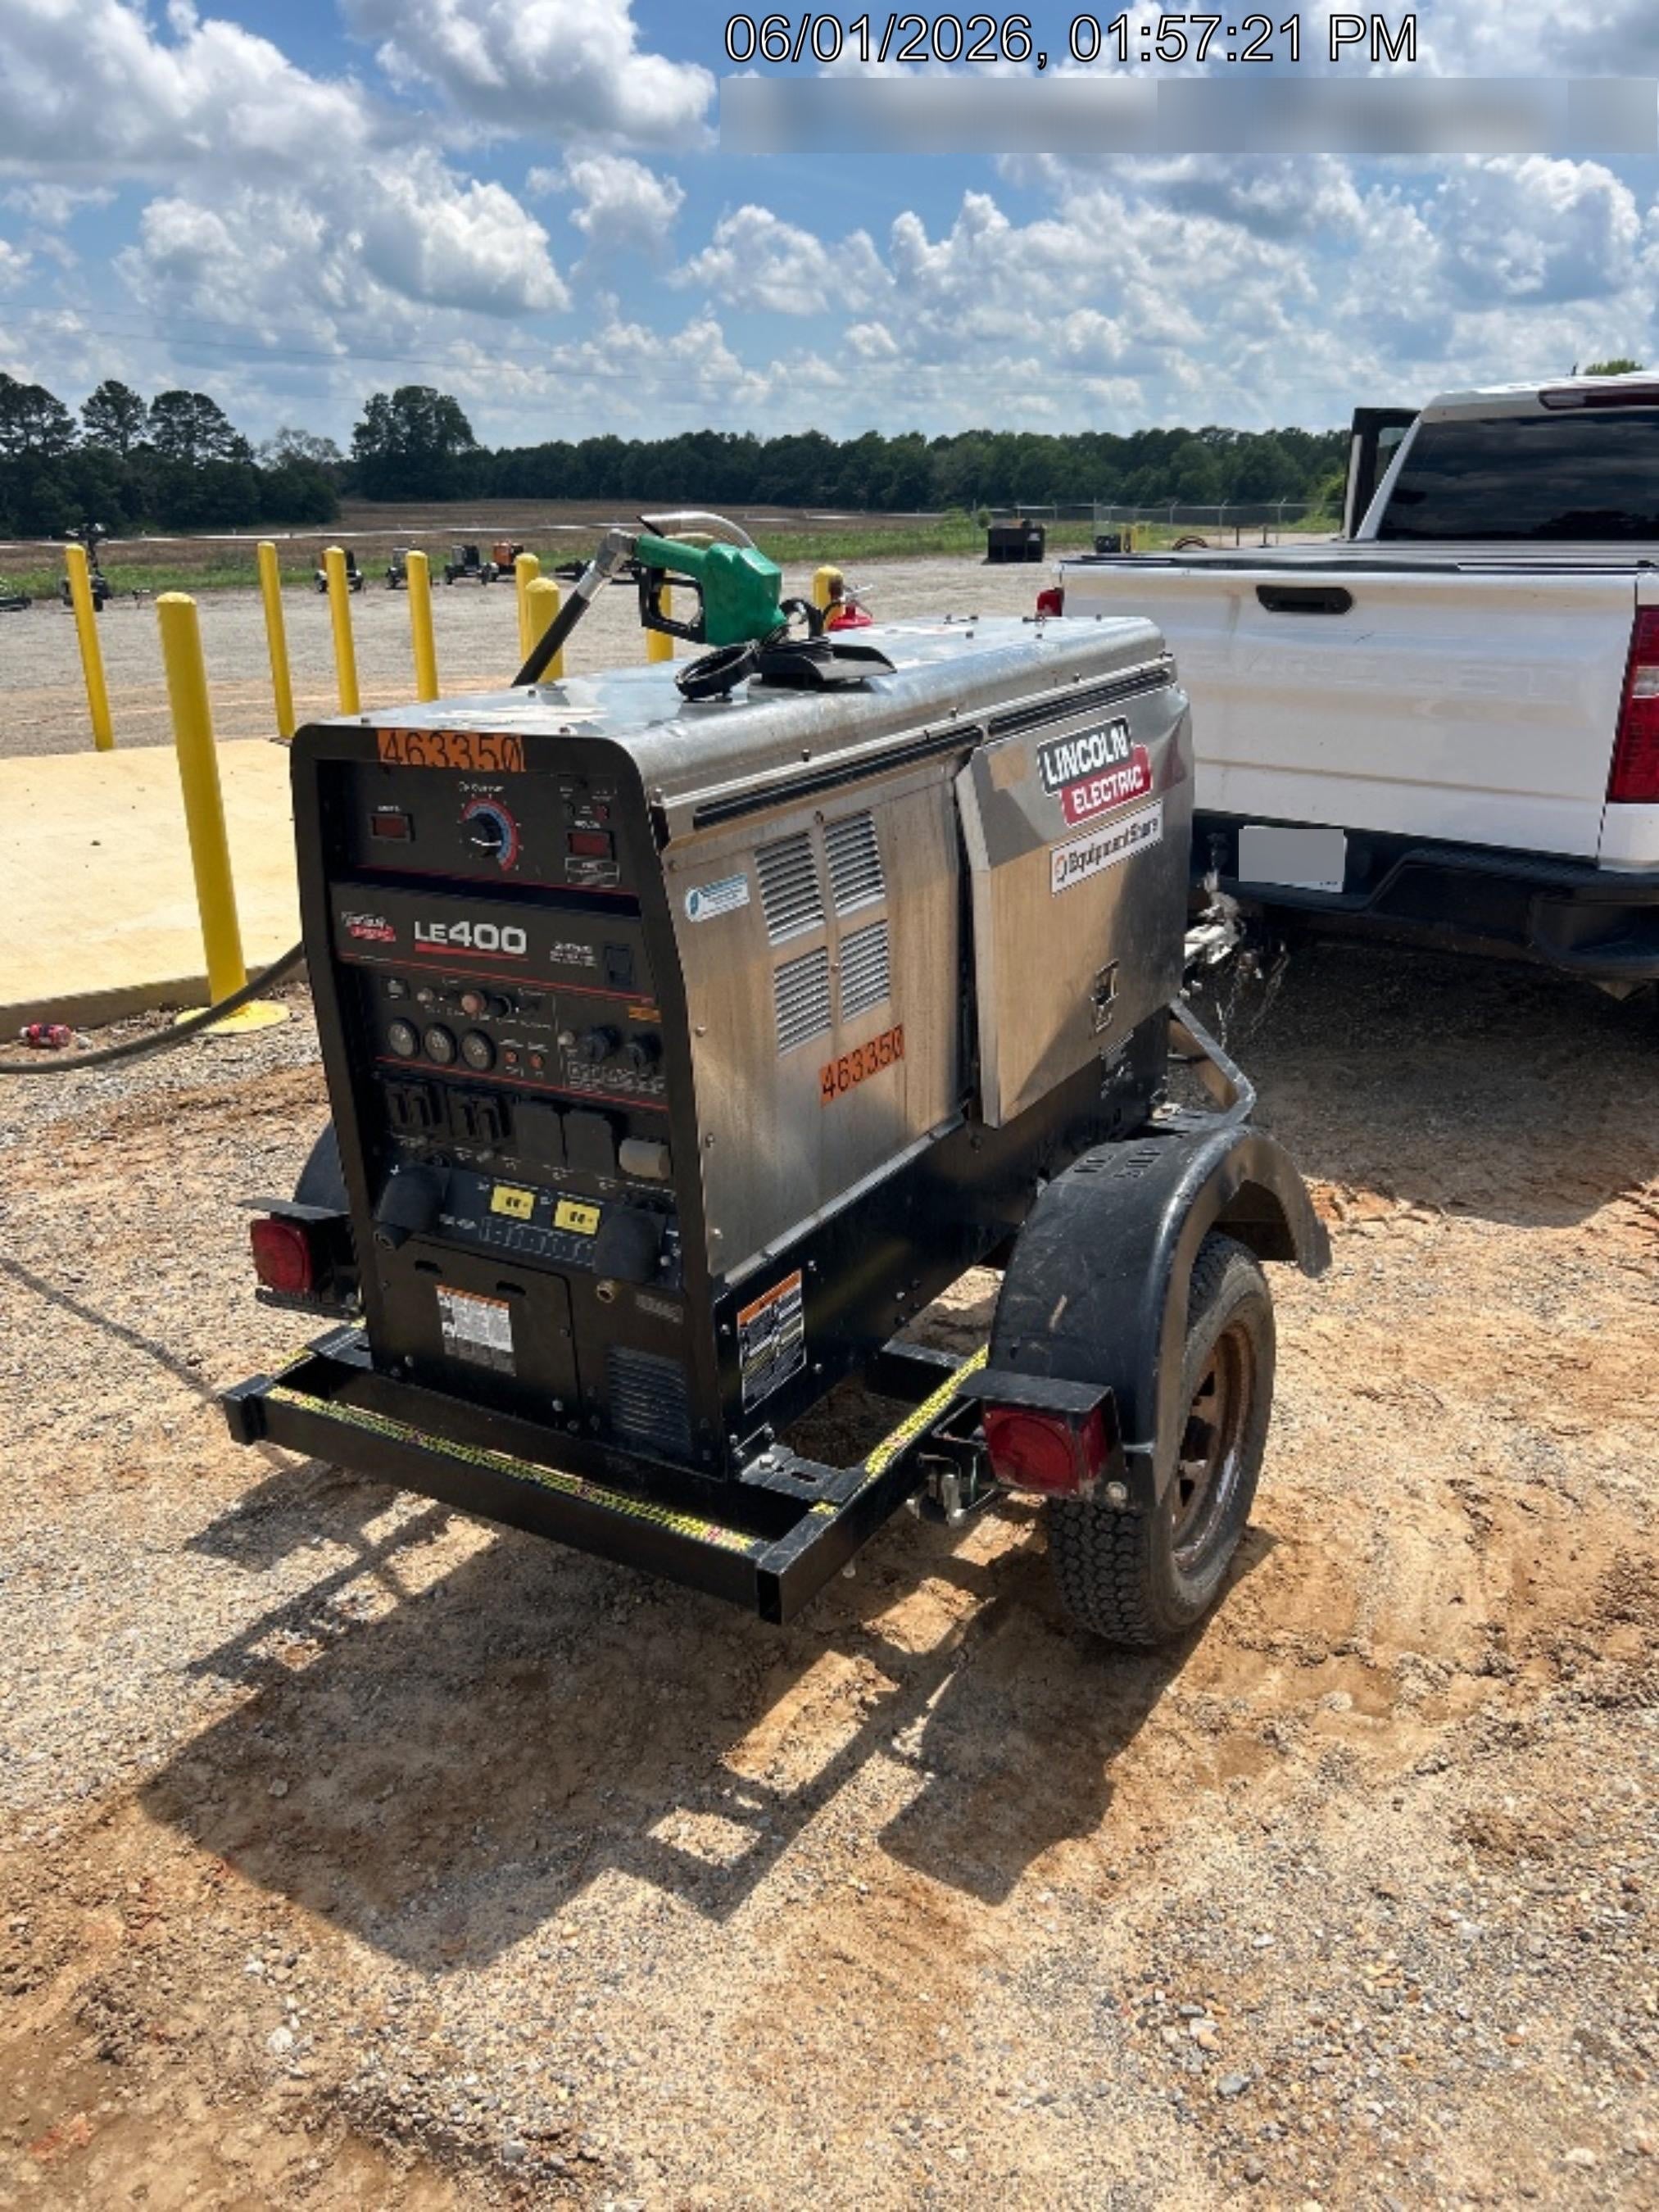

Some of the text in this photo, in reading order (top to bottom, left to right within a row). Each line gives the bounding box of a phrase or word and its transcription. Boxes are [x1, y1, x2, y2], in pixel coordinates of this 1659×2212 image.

[383, 732, 523, 773] 463350
[1043, 723, 1129, 786] LINCOLN
[1071, 764, 1145, 814] ELECTRIC
[414, 920, 527, 954] LE400
[822, 1023, 904, 1099] 463350
